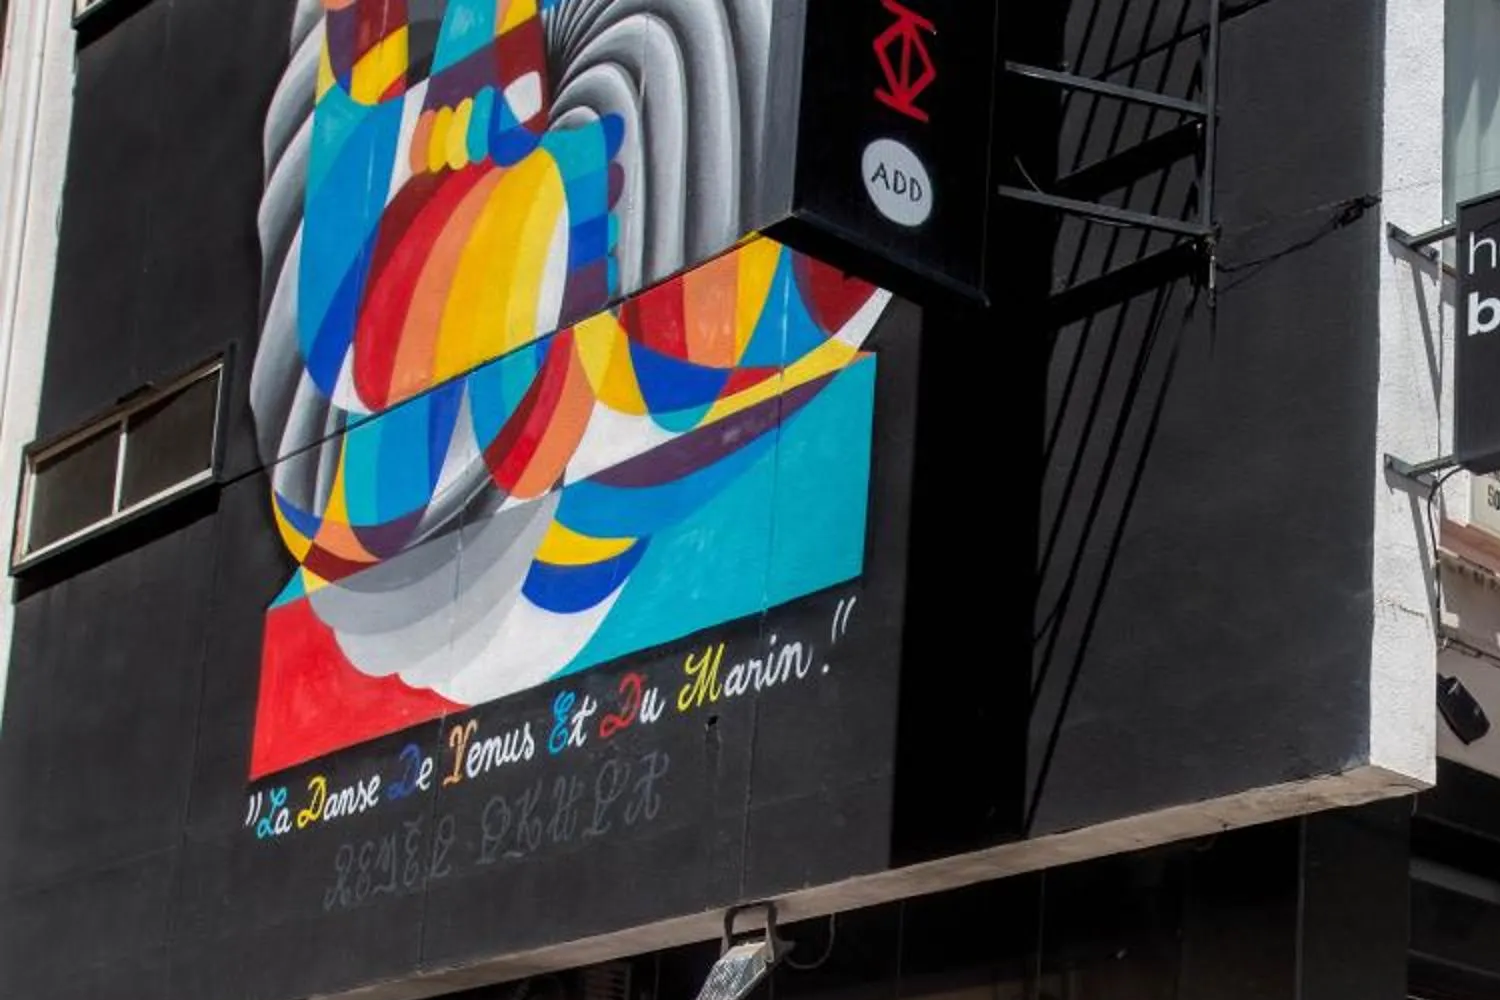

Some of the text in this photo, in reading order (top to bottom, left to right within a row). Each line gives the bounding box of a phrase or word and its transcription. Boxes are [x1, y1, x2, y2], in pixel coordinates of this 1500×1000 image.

[870, 161, 923, 203] ADD
[296, 773, 382, 830] Danse
[385, 742, 433, 801] De
[442, 717, 536, 790] Venus
[545, 690, 599, 754] Et
[599, 671, 666, 738] Du
